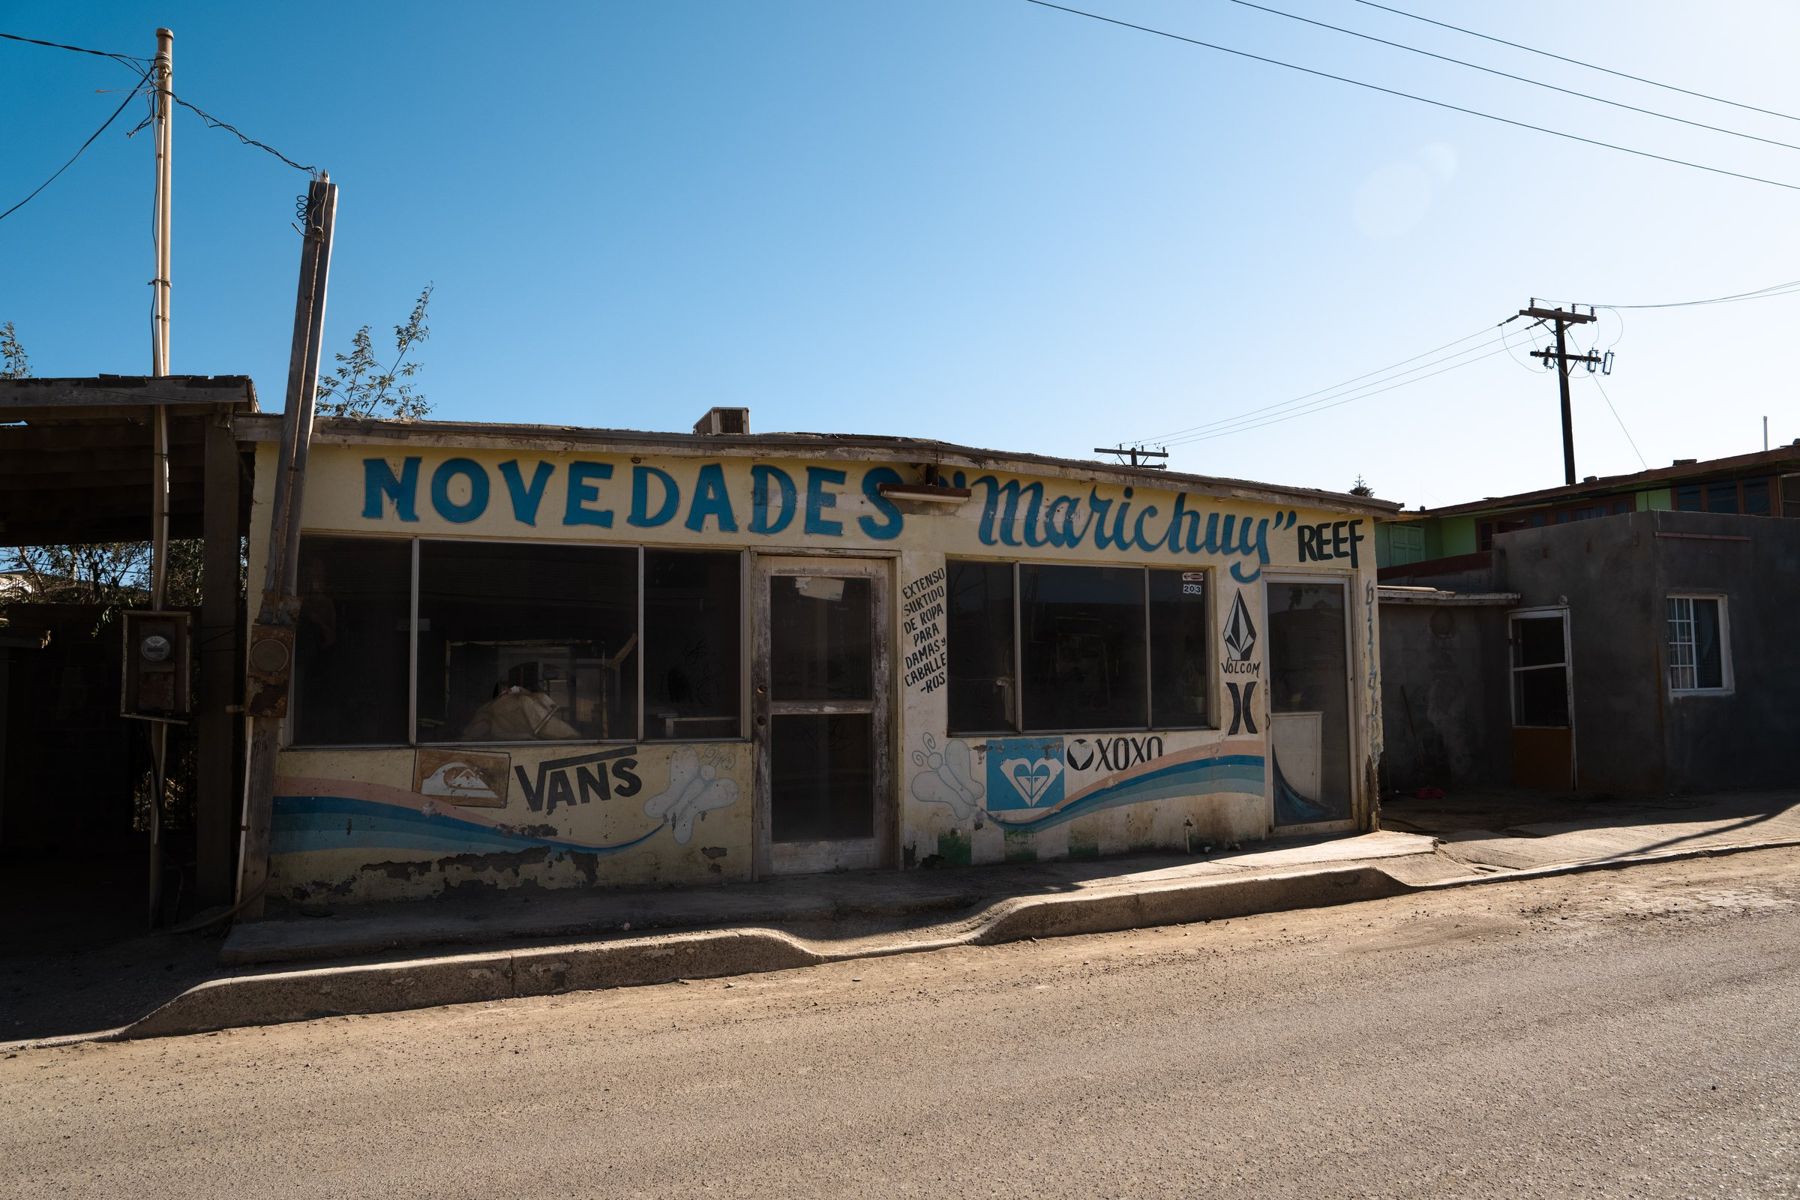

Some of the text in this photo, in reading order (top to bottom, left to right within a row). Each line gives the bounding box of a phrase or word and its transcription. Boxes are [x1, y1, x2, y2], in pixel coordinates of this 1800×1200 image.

[362, 456, 904, 540] NOVEDADES
[1297, 519, 1365, 568] REEF
[903, 567, 946, 599] EXTENSO
[1183, 585, 1201, 594] 203
[903, 585, 945, 617] SURTIDO
[904, 603, 944, 634] DE ROPA
[913, 622, 940, 647] PARA
[904, 652, 947, 687] CABALLE
[905, 640, 941, 669] DAMAS
[1221, 657, 1261, 678] VOLCOM
[1095, 735, 1163, 772] XOXO
[514, 746, 643, 815] VANS
